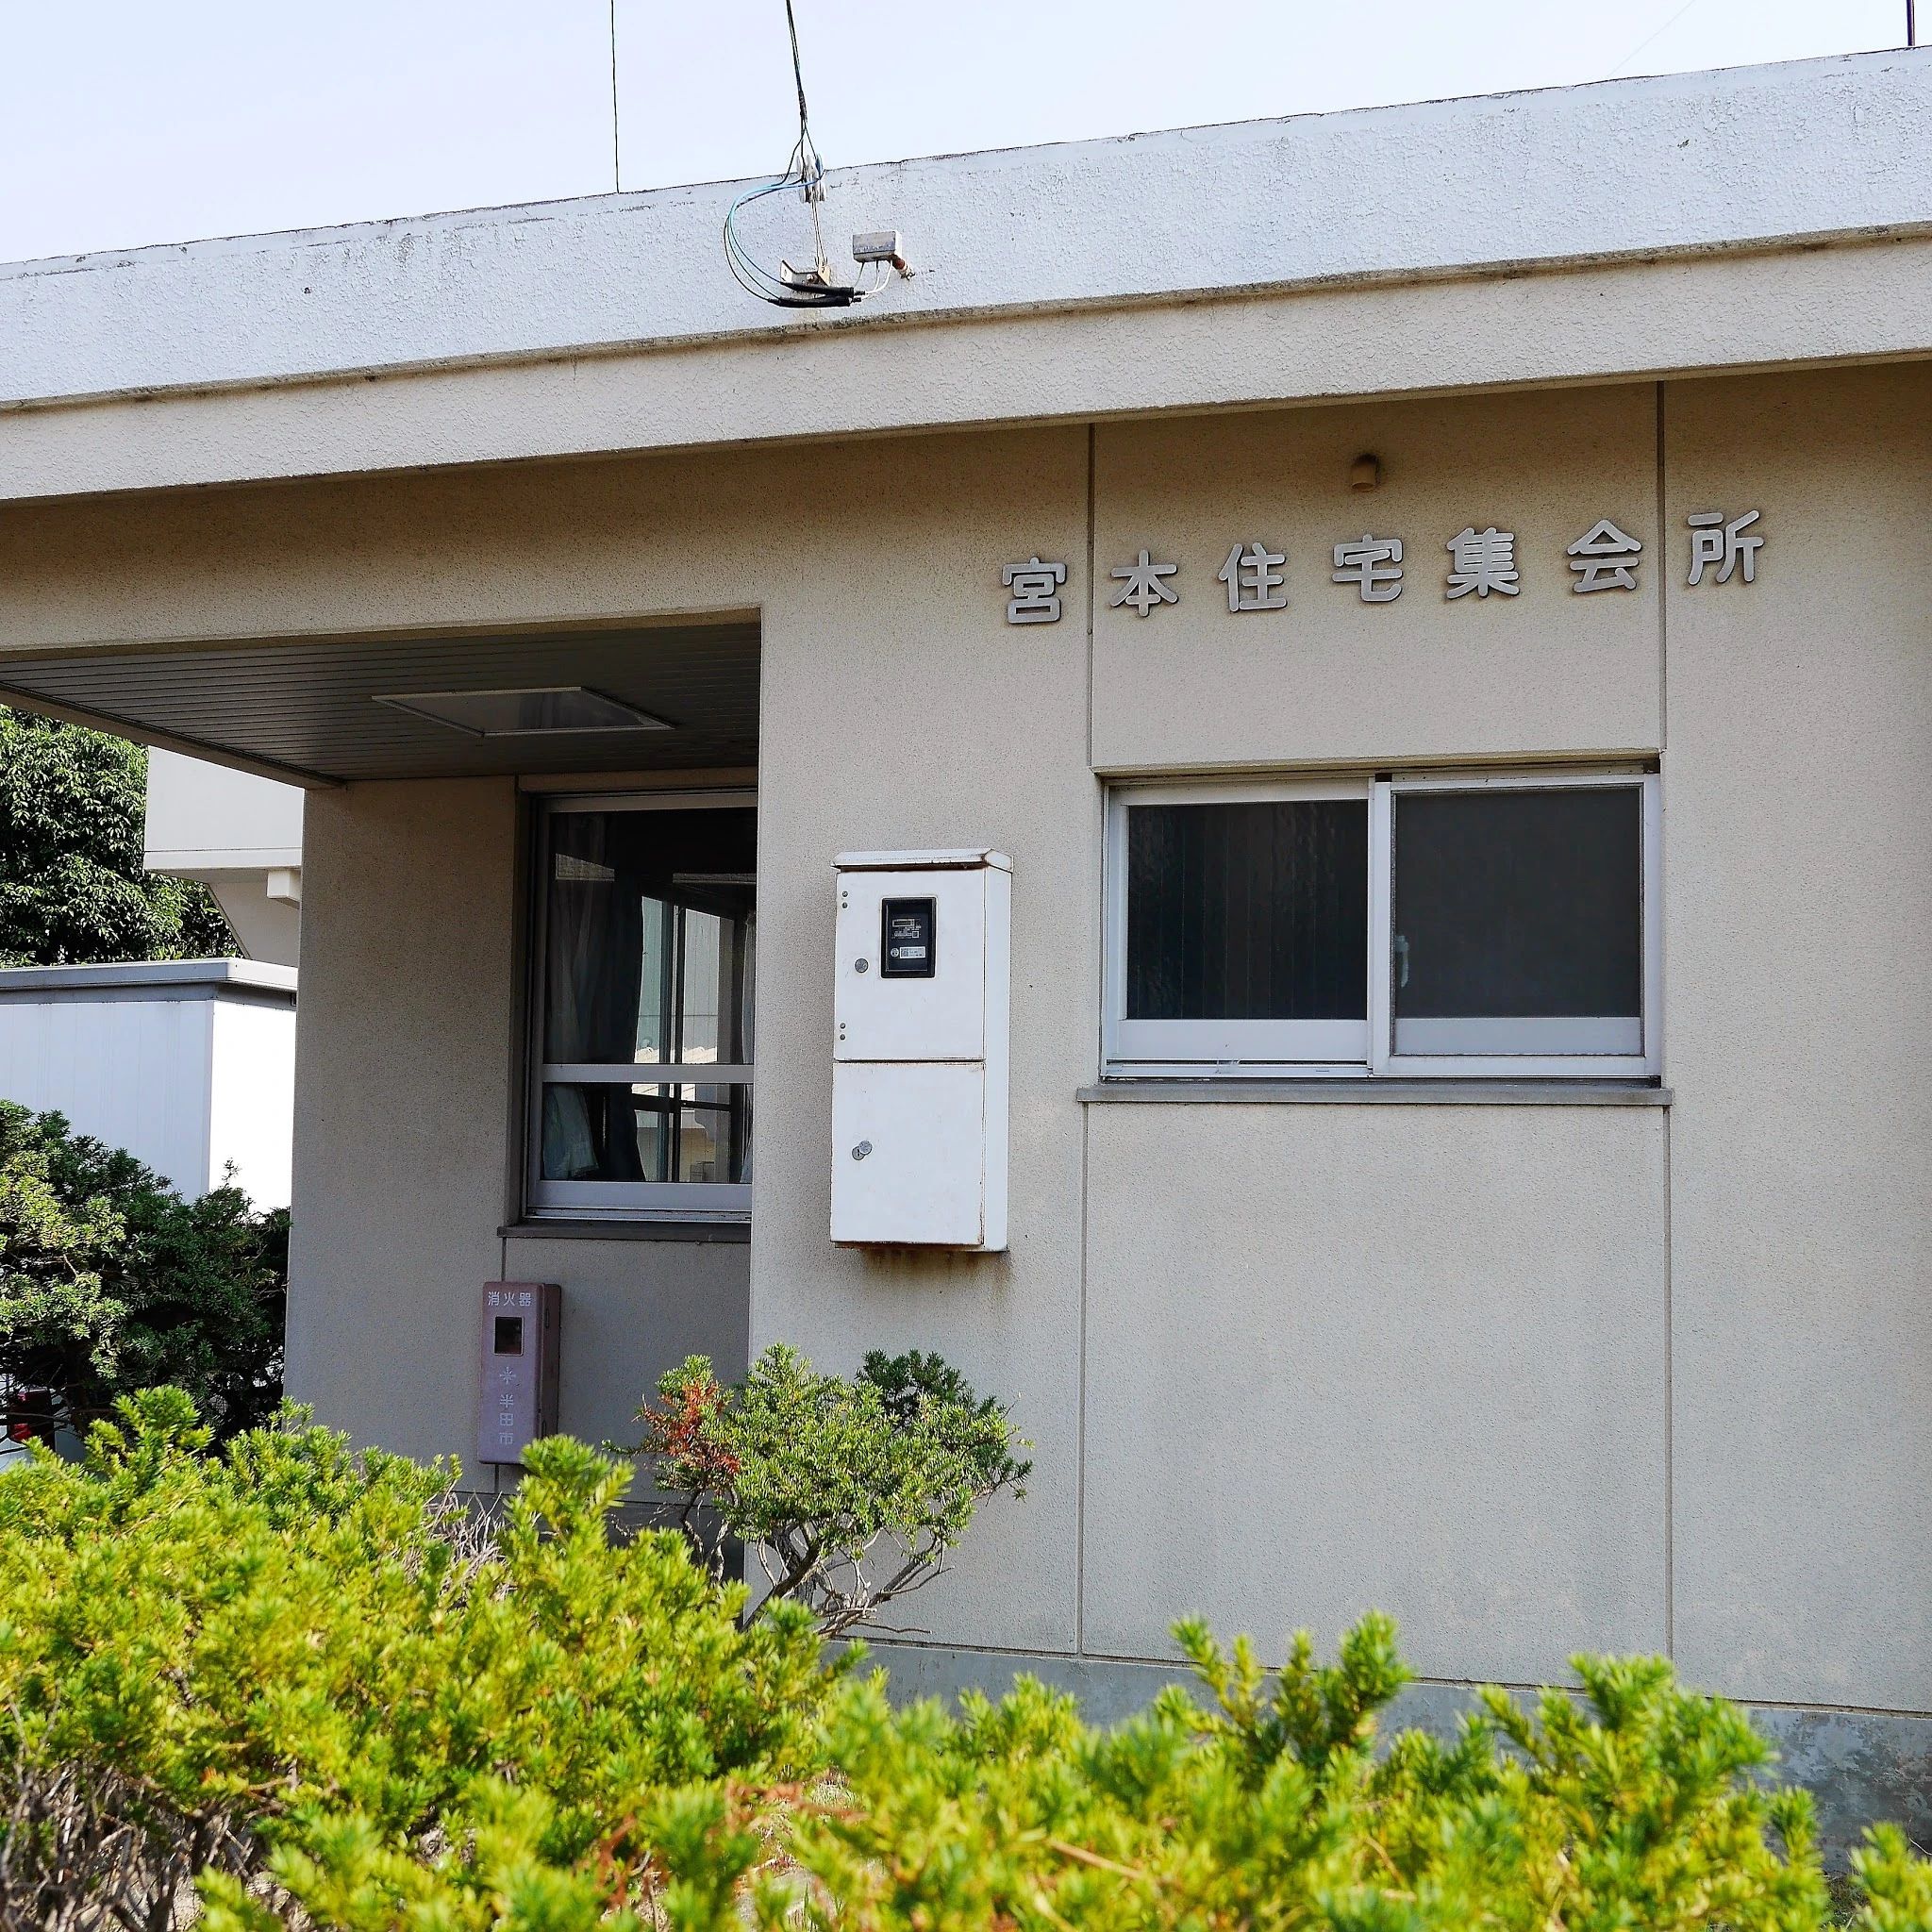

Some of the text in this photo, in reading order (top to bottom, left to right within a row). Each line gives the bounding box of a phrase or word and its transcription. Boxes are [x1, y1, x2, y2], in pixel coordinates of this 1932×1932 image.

[1002, 509, 1765, 625] 宮本住宅集会所
[488, 1291, 533, 1307] 消火器
[498, 1393, 515, 1445] 半田市
